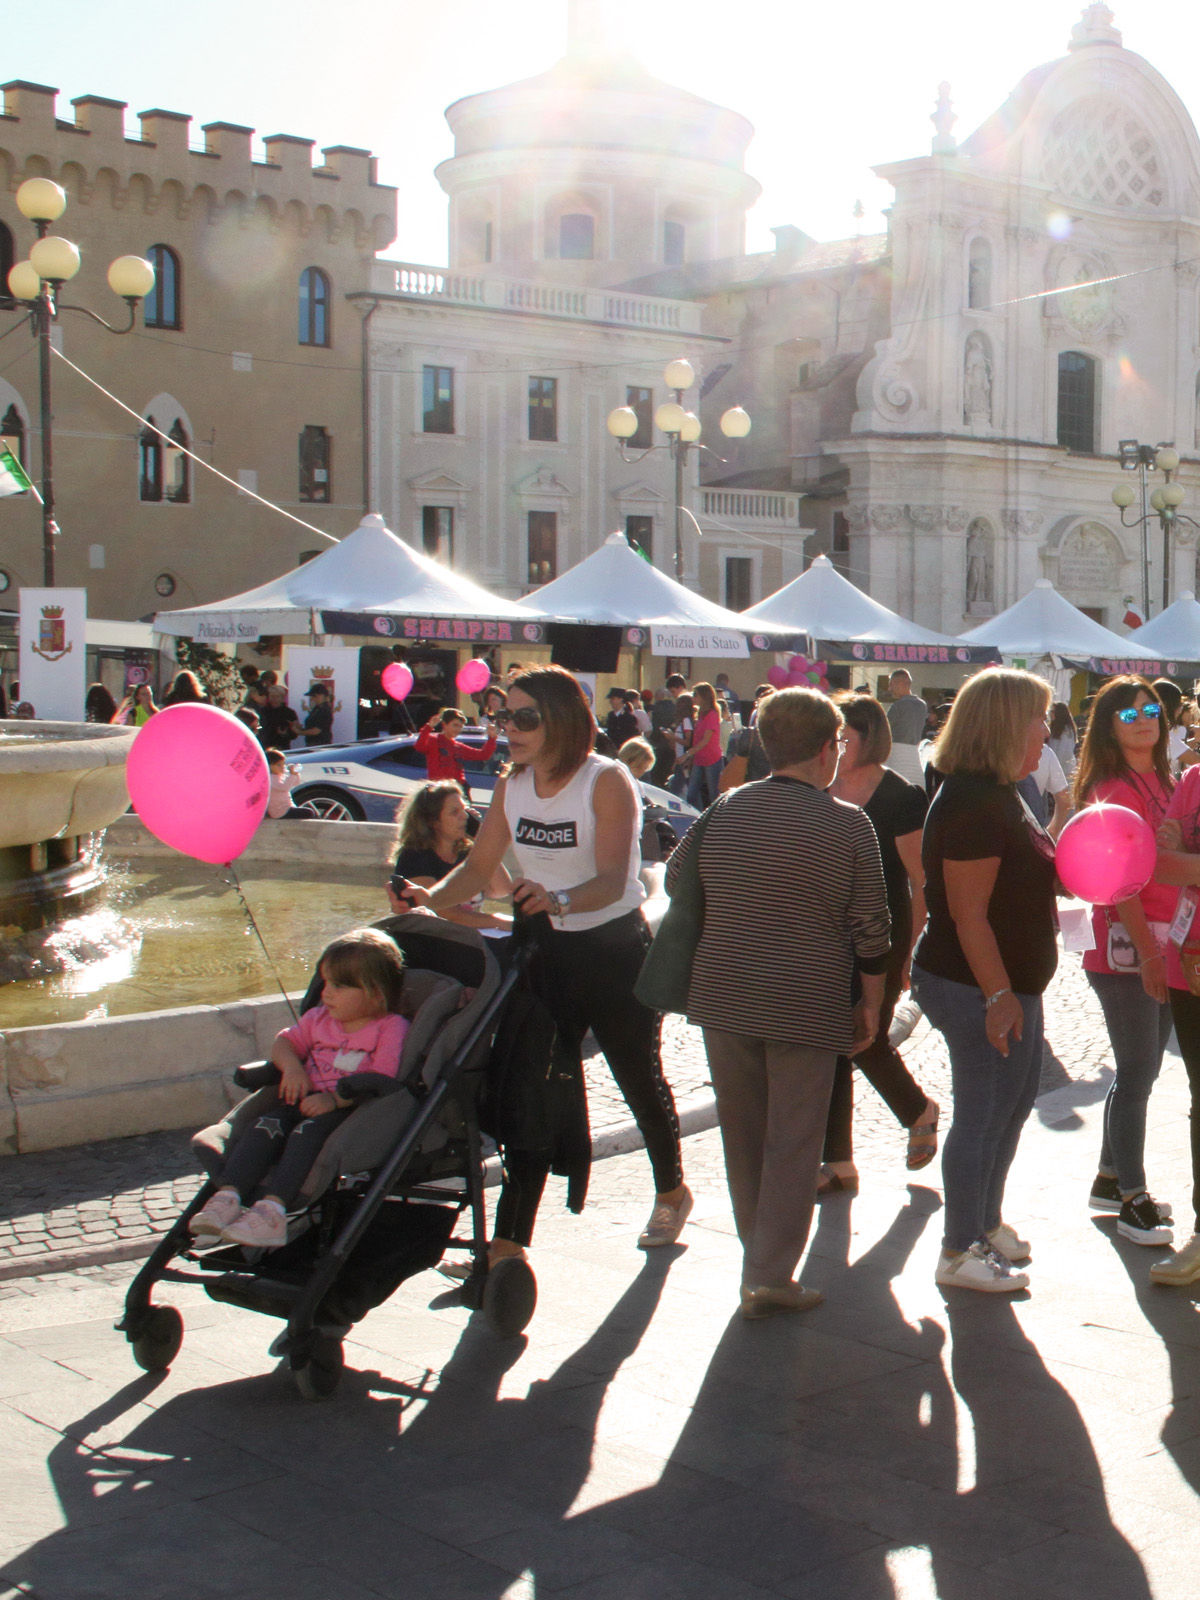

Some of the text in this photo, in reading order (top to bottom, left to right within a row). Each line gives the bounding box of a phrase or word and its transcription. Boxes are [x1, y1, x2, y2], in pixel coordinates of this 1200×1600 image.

[198, 622, 226, 638] Polizia
[237, 622, 258, 638] Stato
[403, 617, 513, 641] SHARPER
[656, 634, 740, 650] Polizia di Stato
[873, 644, 950, 662] SHARPER
[321, 766, 351, 775] 113
[516, 825, 574, 844] J'ADORE
